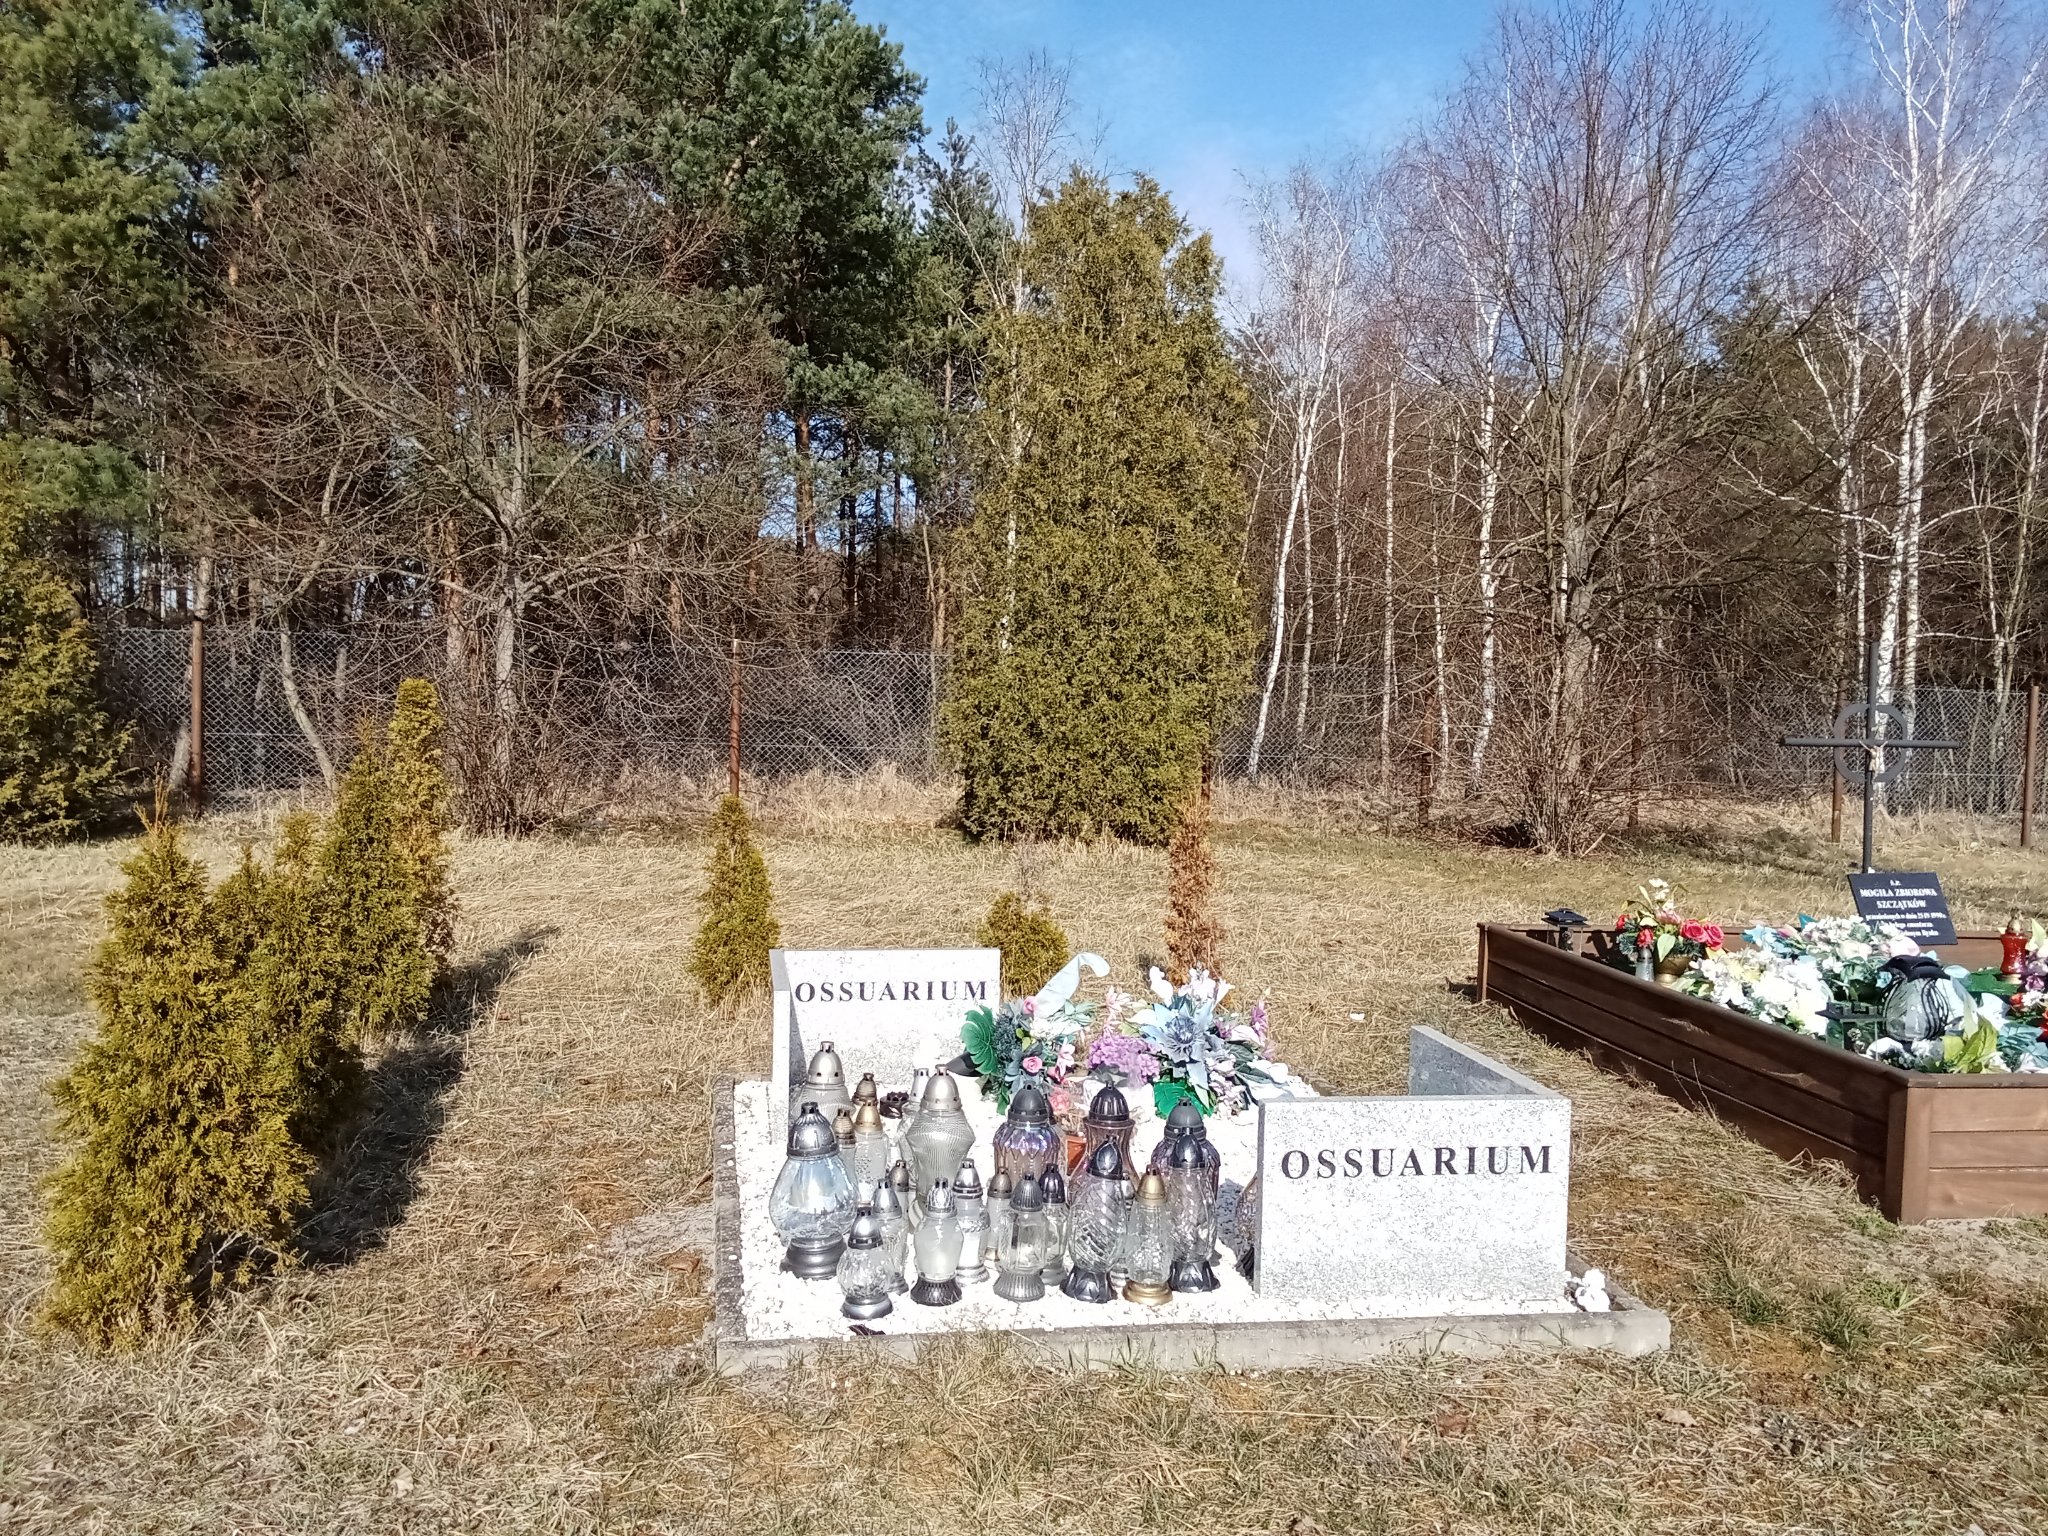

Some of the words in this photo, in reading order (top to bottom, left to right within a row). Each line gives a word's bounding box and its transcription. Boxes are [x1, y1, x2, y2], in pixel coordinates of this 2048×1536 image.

[1894, 887, 1938, 897] ZBIOROWA
[1876, 898, 1927, 910] SZCZĄTKÓW
[794, 980, 987, 1003] OSSUARIUM
[1281, 1145, 1553, 1180] OSSUARIUM
